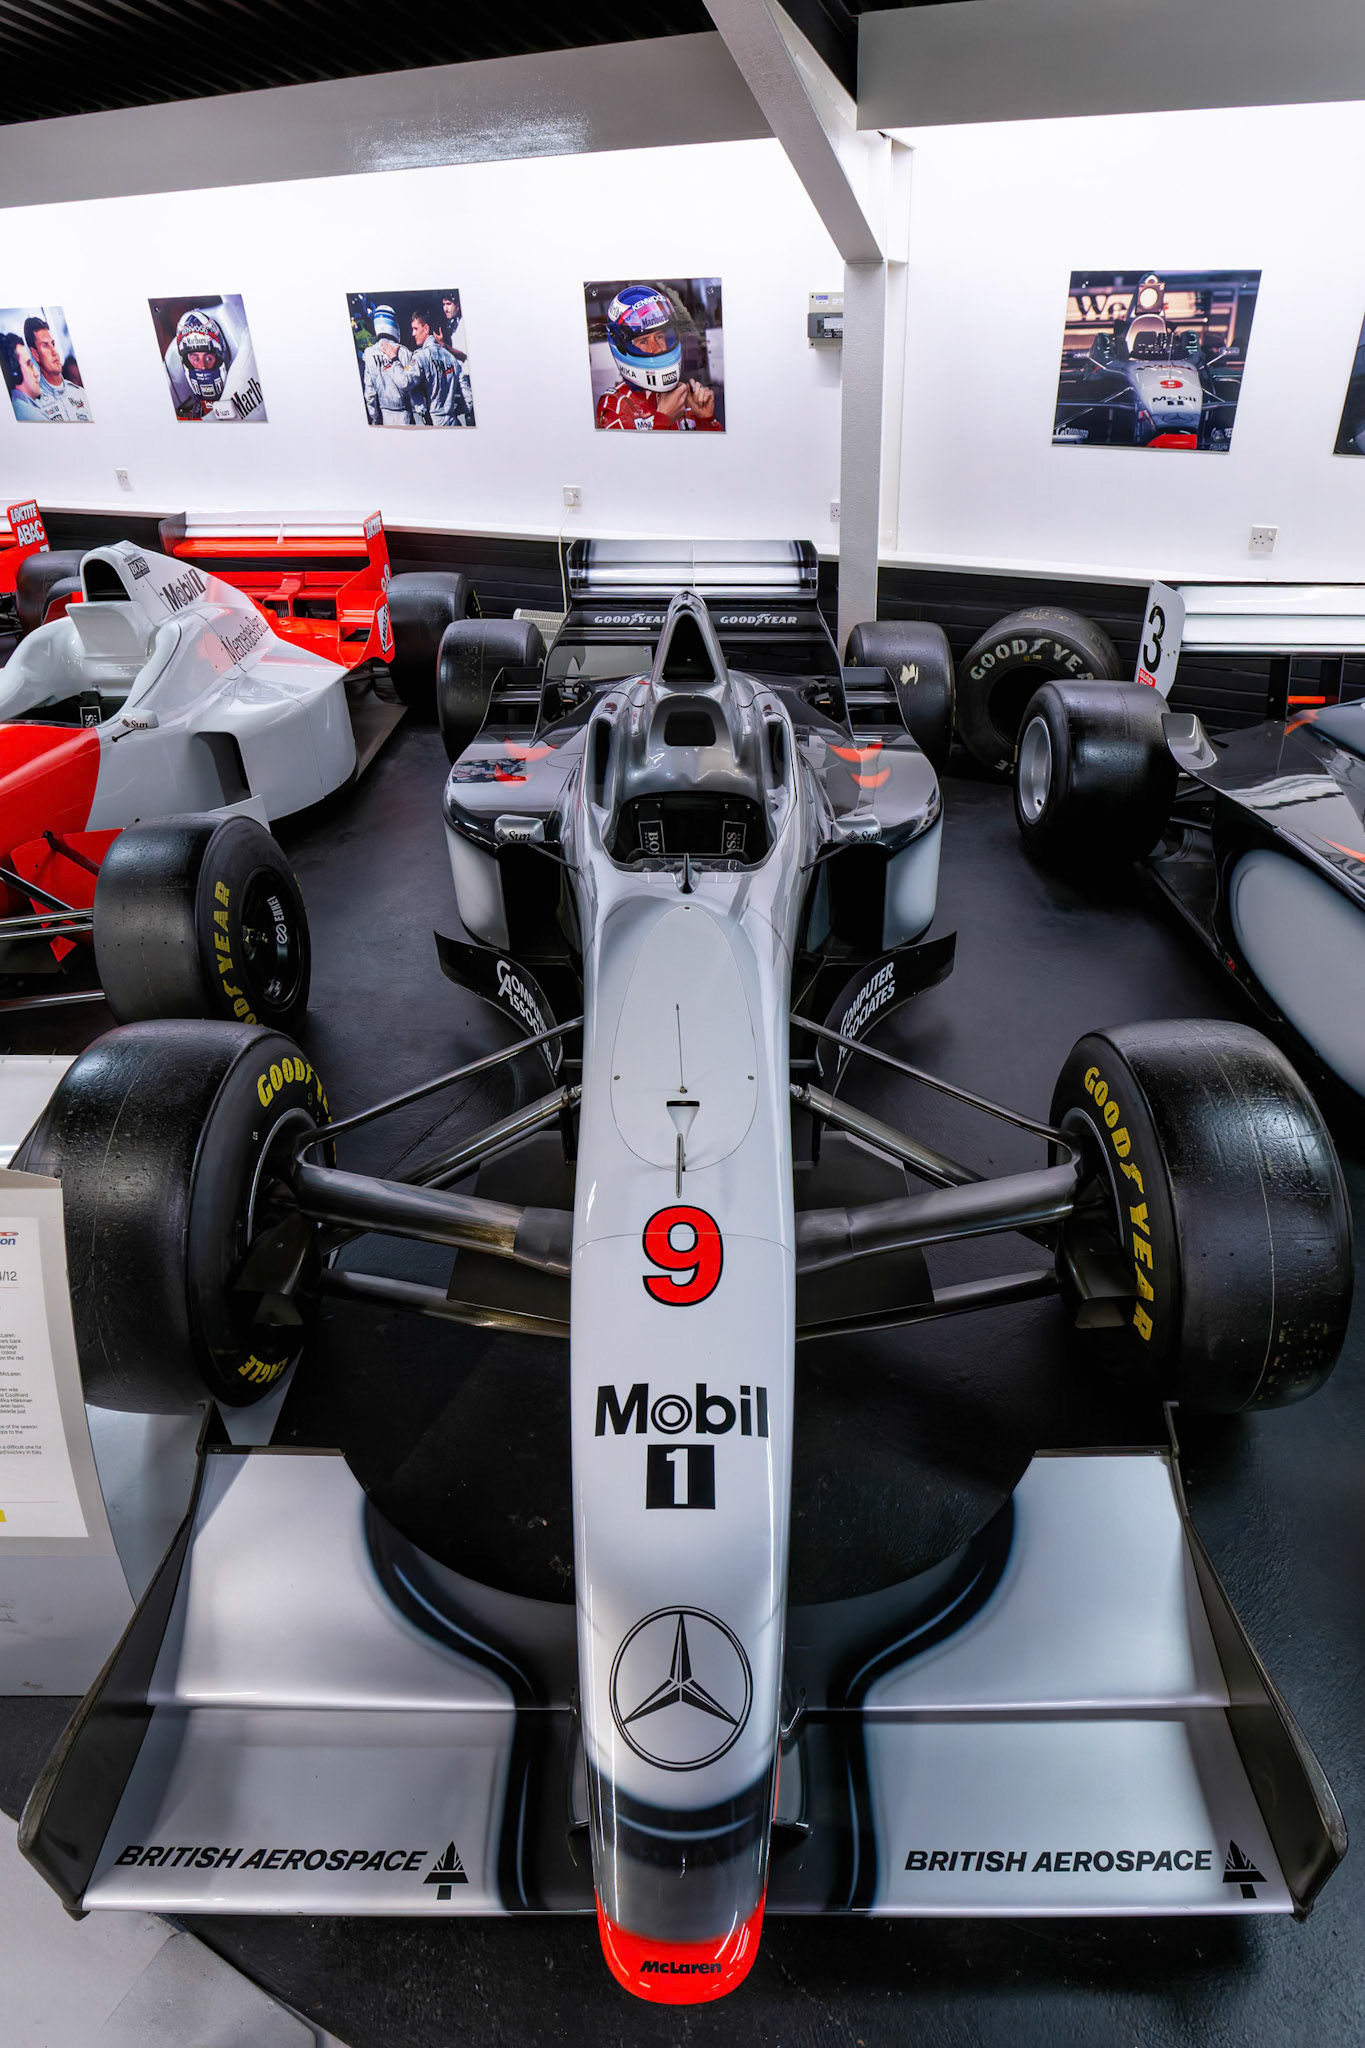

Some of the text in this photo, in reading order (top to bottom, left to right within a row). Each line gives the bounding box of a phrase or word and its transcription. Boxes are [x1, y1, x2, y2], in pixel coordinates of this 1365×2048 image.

[16, 519, 45, 548] ABAC
[720, 612, 798, 627] GOODYEAR
[1143, 605, 1166, 674] 3
[508, 830, 532, 841] Sun
[1084, 1066, 1154, 1342] GOODYEAR
[642, 1205, 724, 1307] 9
[594, 1383, 769, 1438] Mobil
[114, 1845, 428, 1872] BRITISH AEROSPACE
[904, 1849, 1213, 1873] BRITISH AEROSPACE
[640, 1960, 722, 1974] McLaren
